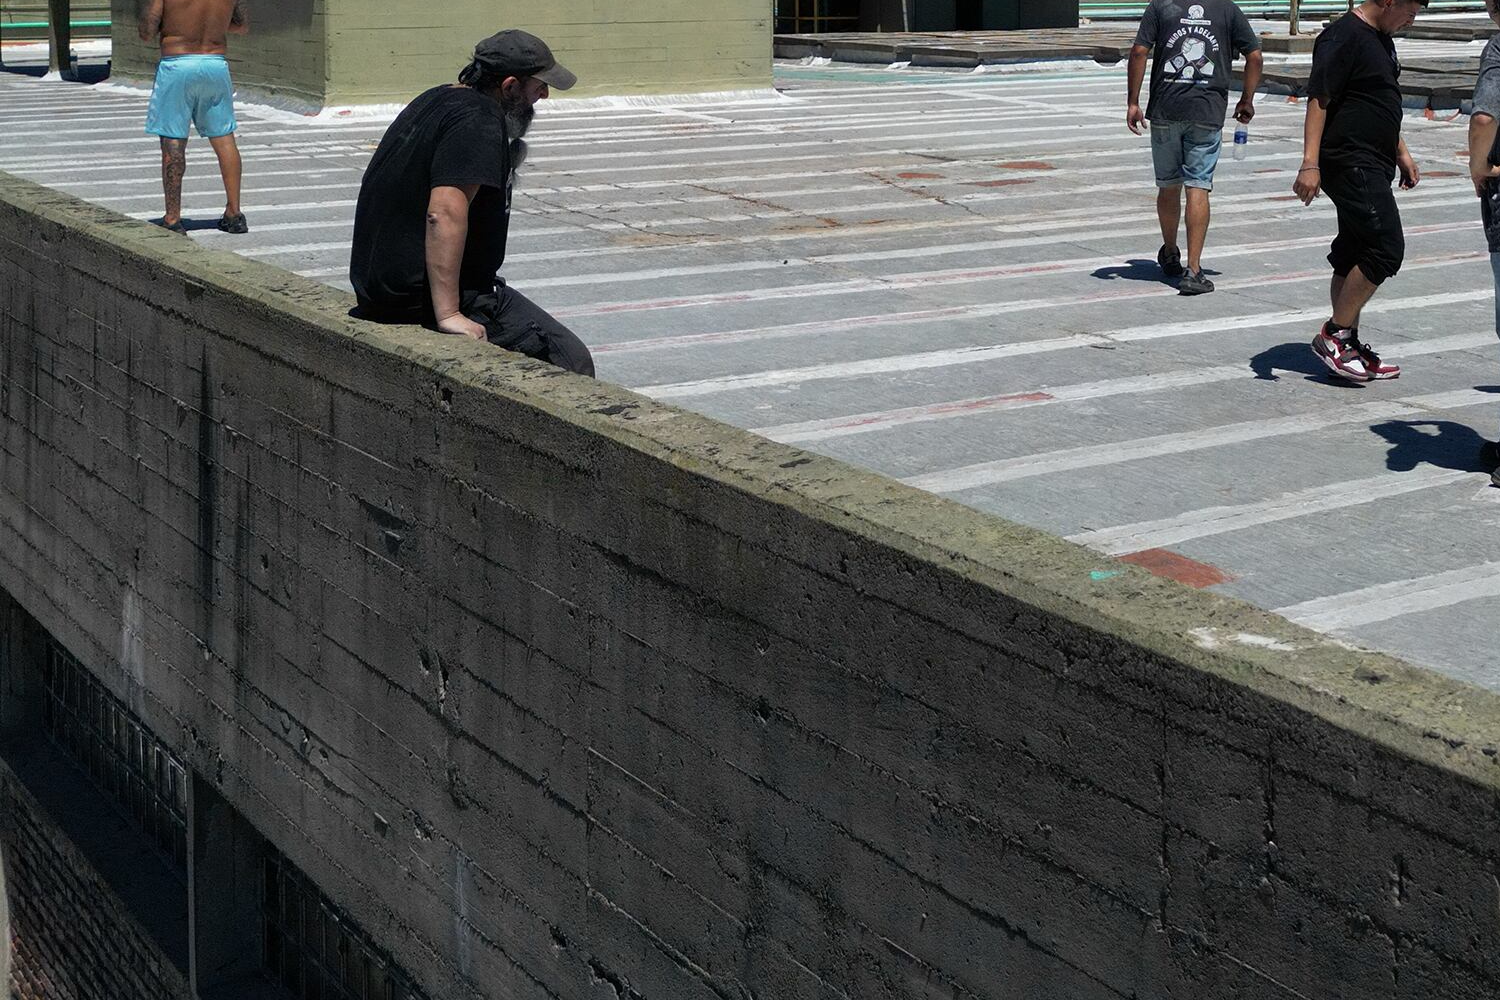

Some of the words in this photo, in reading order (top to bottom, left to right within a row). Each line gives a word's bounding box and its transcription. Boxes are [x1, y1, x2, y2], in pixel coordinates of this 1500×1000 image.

[1166, 27, 1187, 49] UNIDOS
[1187, 26, 1193, 34] Y
[1193, 26, 1220, 52] ADELANTE
